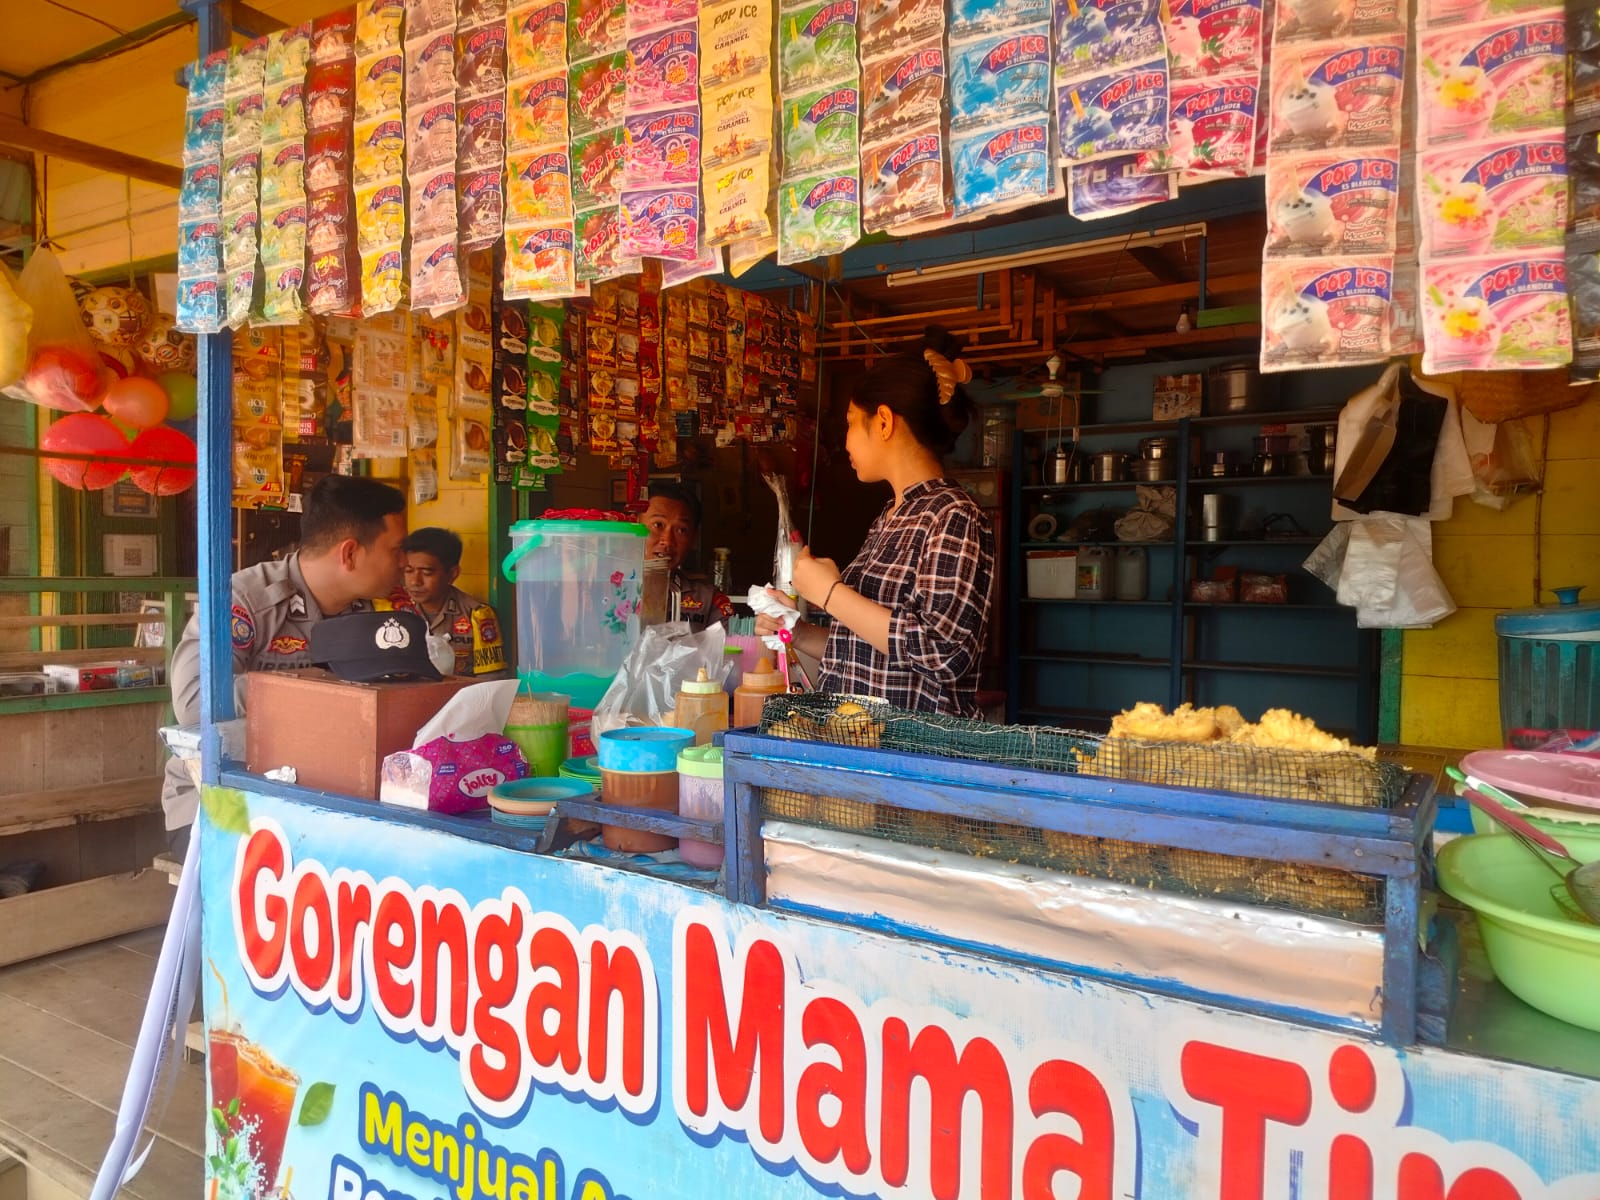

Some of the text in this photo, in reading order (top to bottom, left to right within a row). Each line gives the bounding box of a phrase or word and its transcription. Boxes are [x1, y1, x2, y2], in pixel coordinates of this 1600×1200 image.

[238, 827, 646, 1102] Gorengan
[685, 921, 1116, 1200] Mama
[364, 1091, 557, 1200] Menjual
